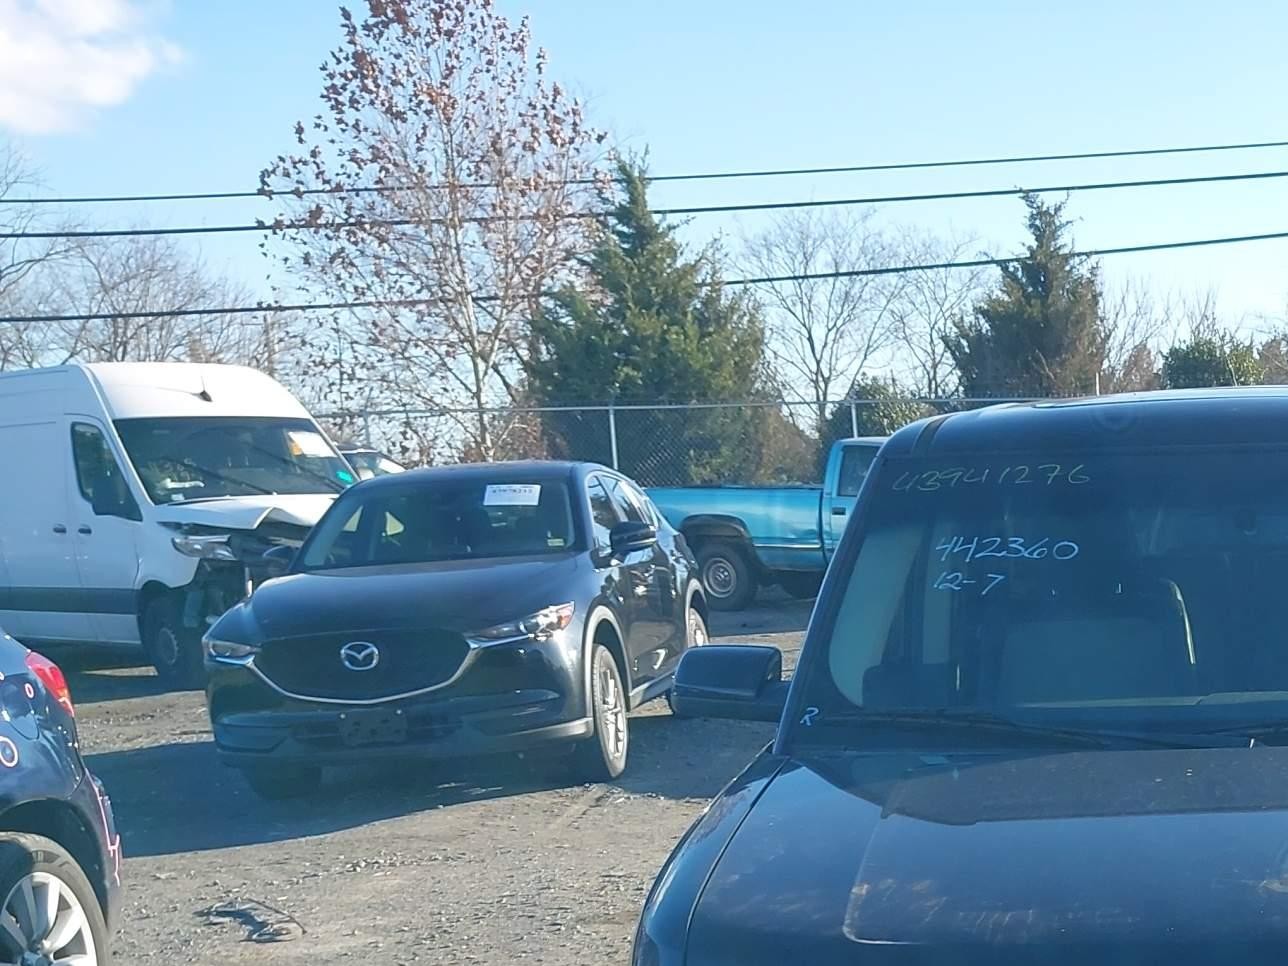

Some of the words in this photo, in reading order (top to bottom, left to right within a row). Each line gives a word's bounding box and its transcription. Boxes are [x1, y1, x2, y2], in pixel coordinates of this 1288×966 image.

[892, 464, 1090, 492] 43941276
[936, 536, 1079, 563] 442360
[799, 707, 819, 726] R
